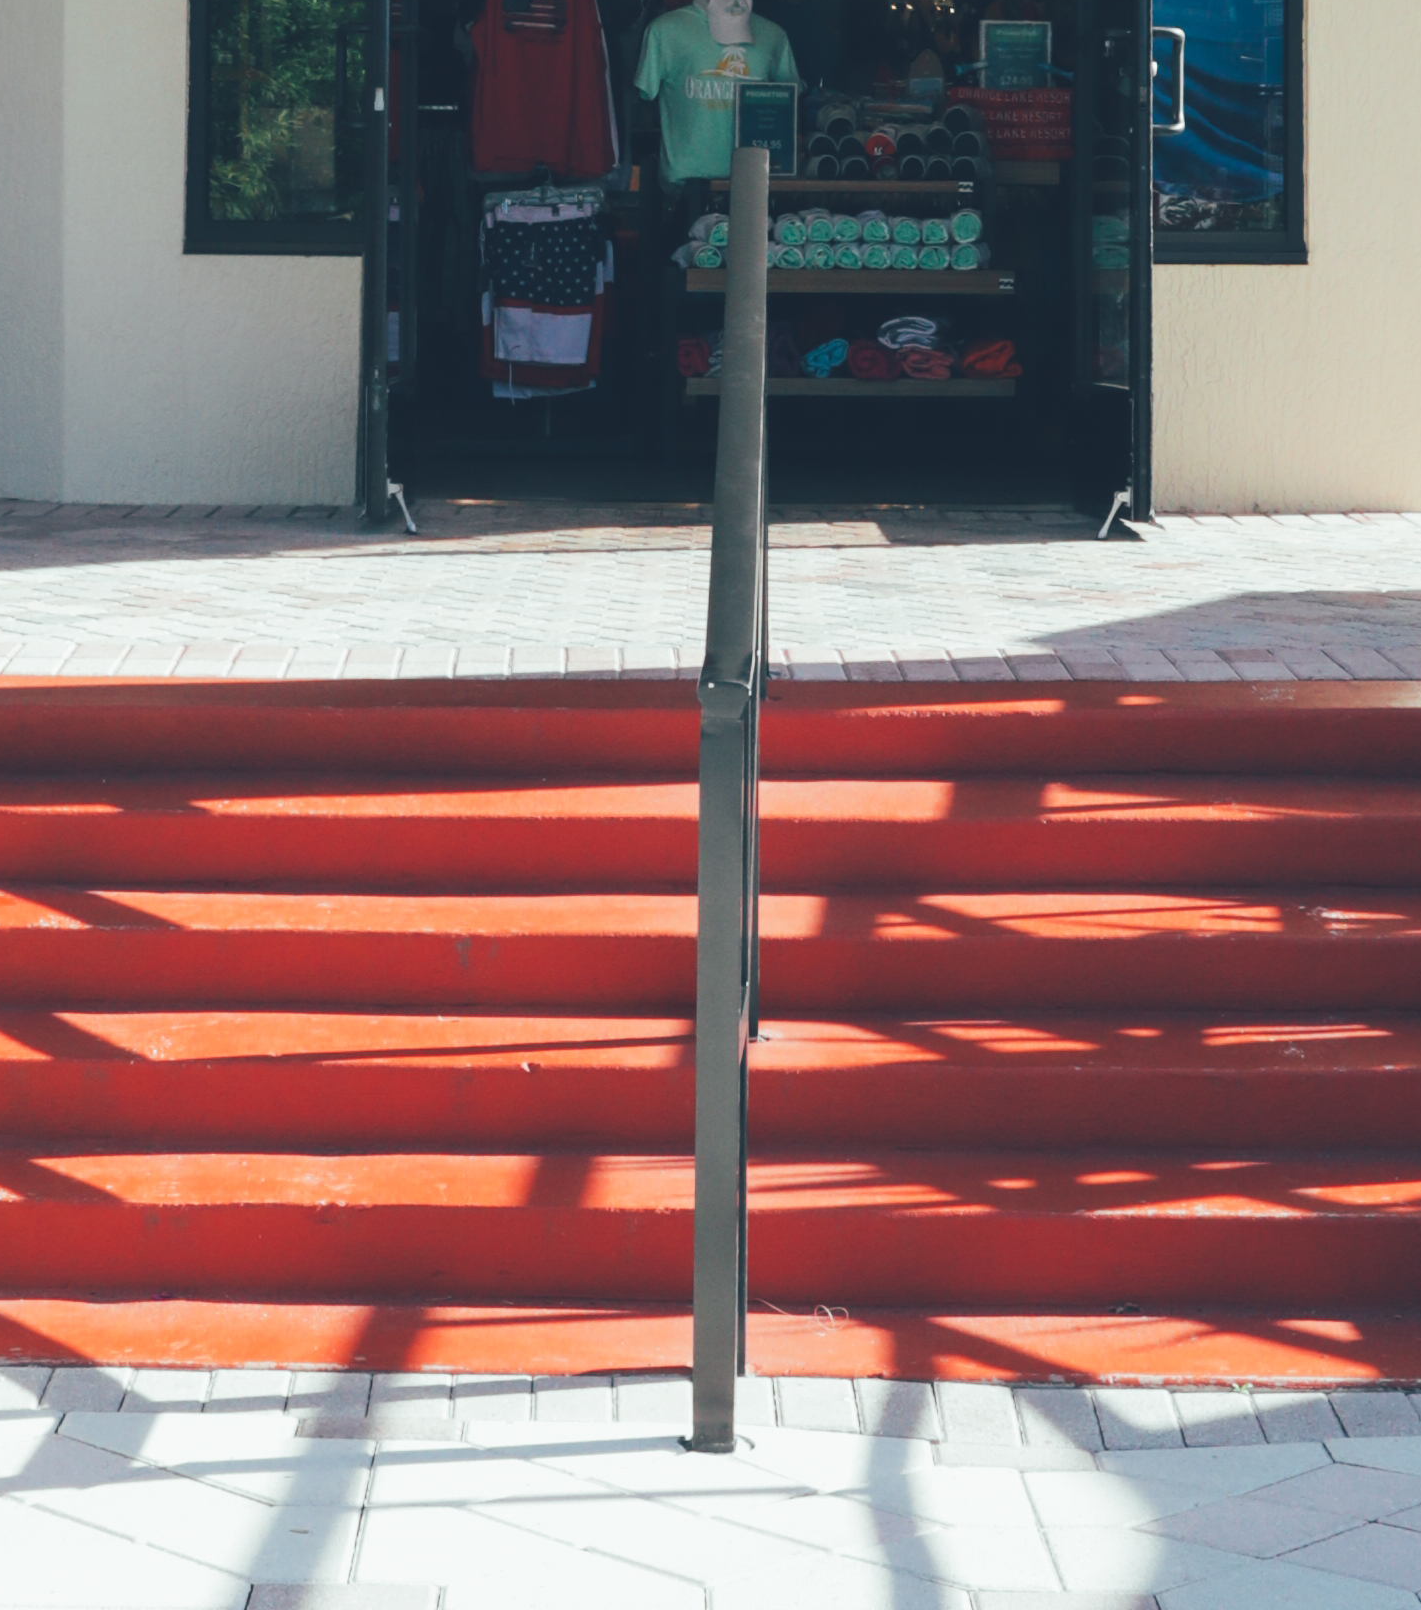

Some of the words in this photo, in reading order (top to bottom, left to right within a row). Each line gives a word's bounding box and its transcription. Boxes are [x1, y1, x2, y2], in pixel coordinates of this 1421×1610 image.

[1005, 91, 1033, 103] LAKE
[1036, 91, 1070, 104] RESOR
[989, 110, 1018, 122] LAKE
[996, 128, 1026, 139] LAKE
